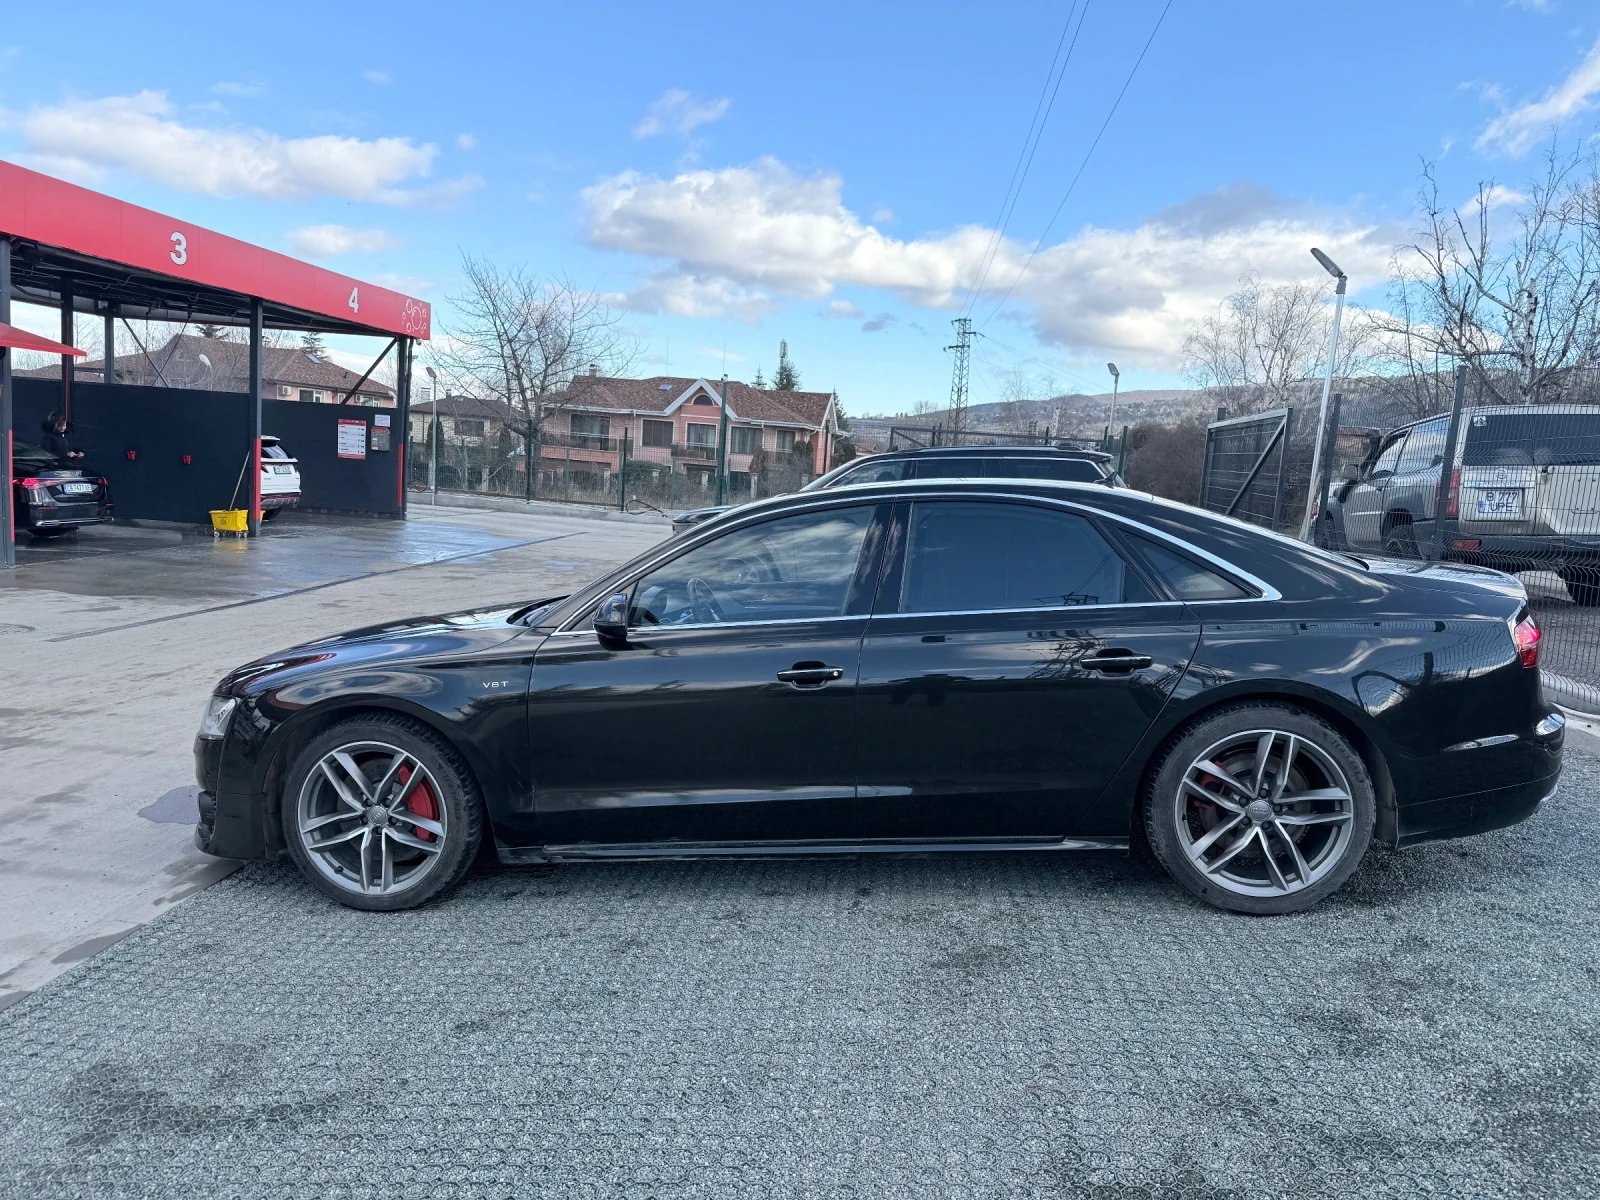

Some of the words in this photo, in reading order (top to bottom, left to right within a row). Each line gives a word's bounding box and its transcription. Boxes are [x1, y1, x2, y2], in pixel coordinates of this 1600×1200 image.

[170, 231, 187, 266] 3
[348, 286, 359, 314] 4
[1499, 492, 1517, 502] 777
[1490, 502, 1513, 511] UPE
[482, 680, 509, 689] V8T
